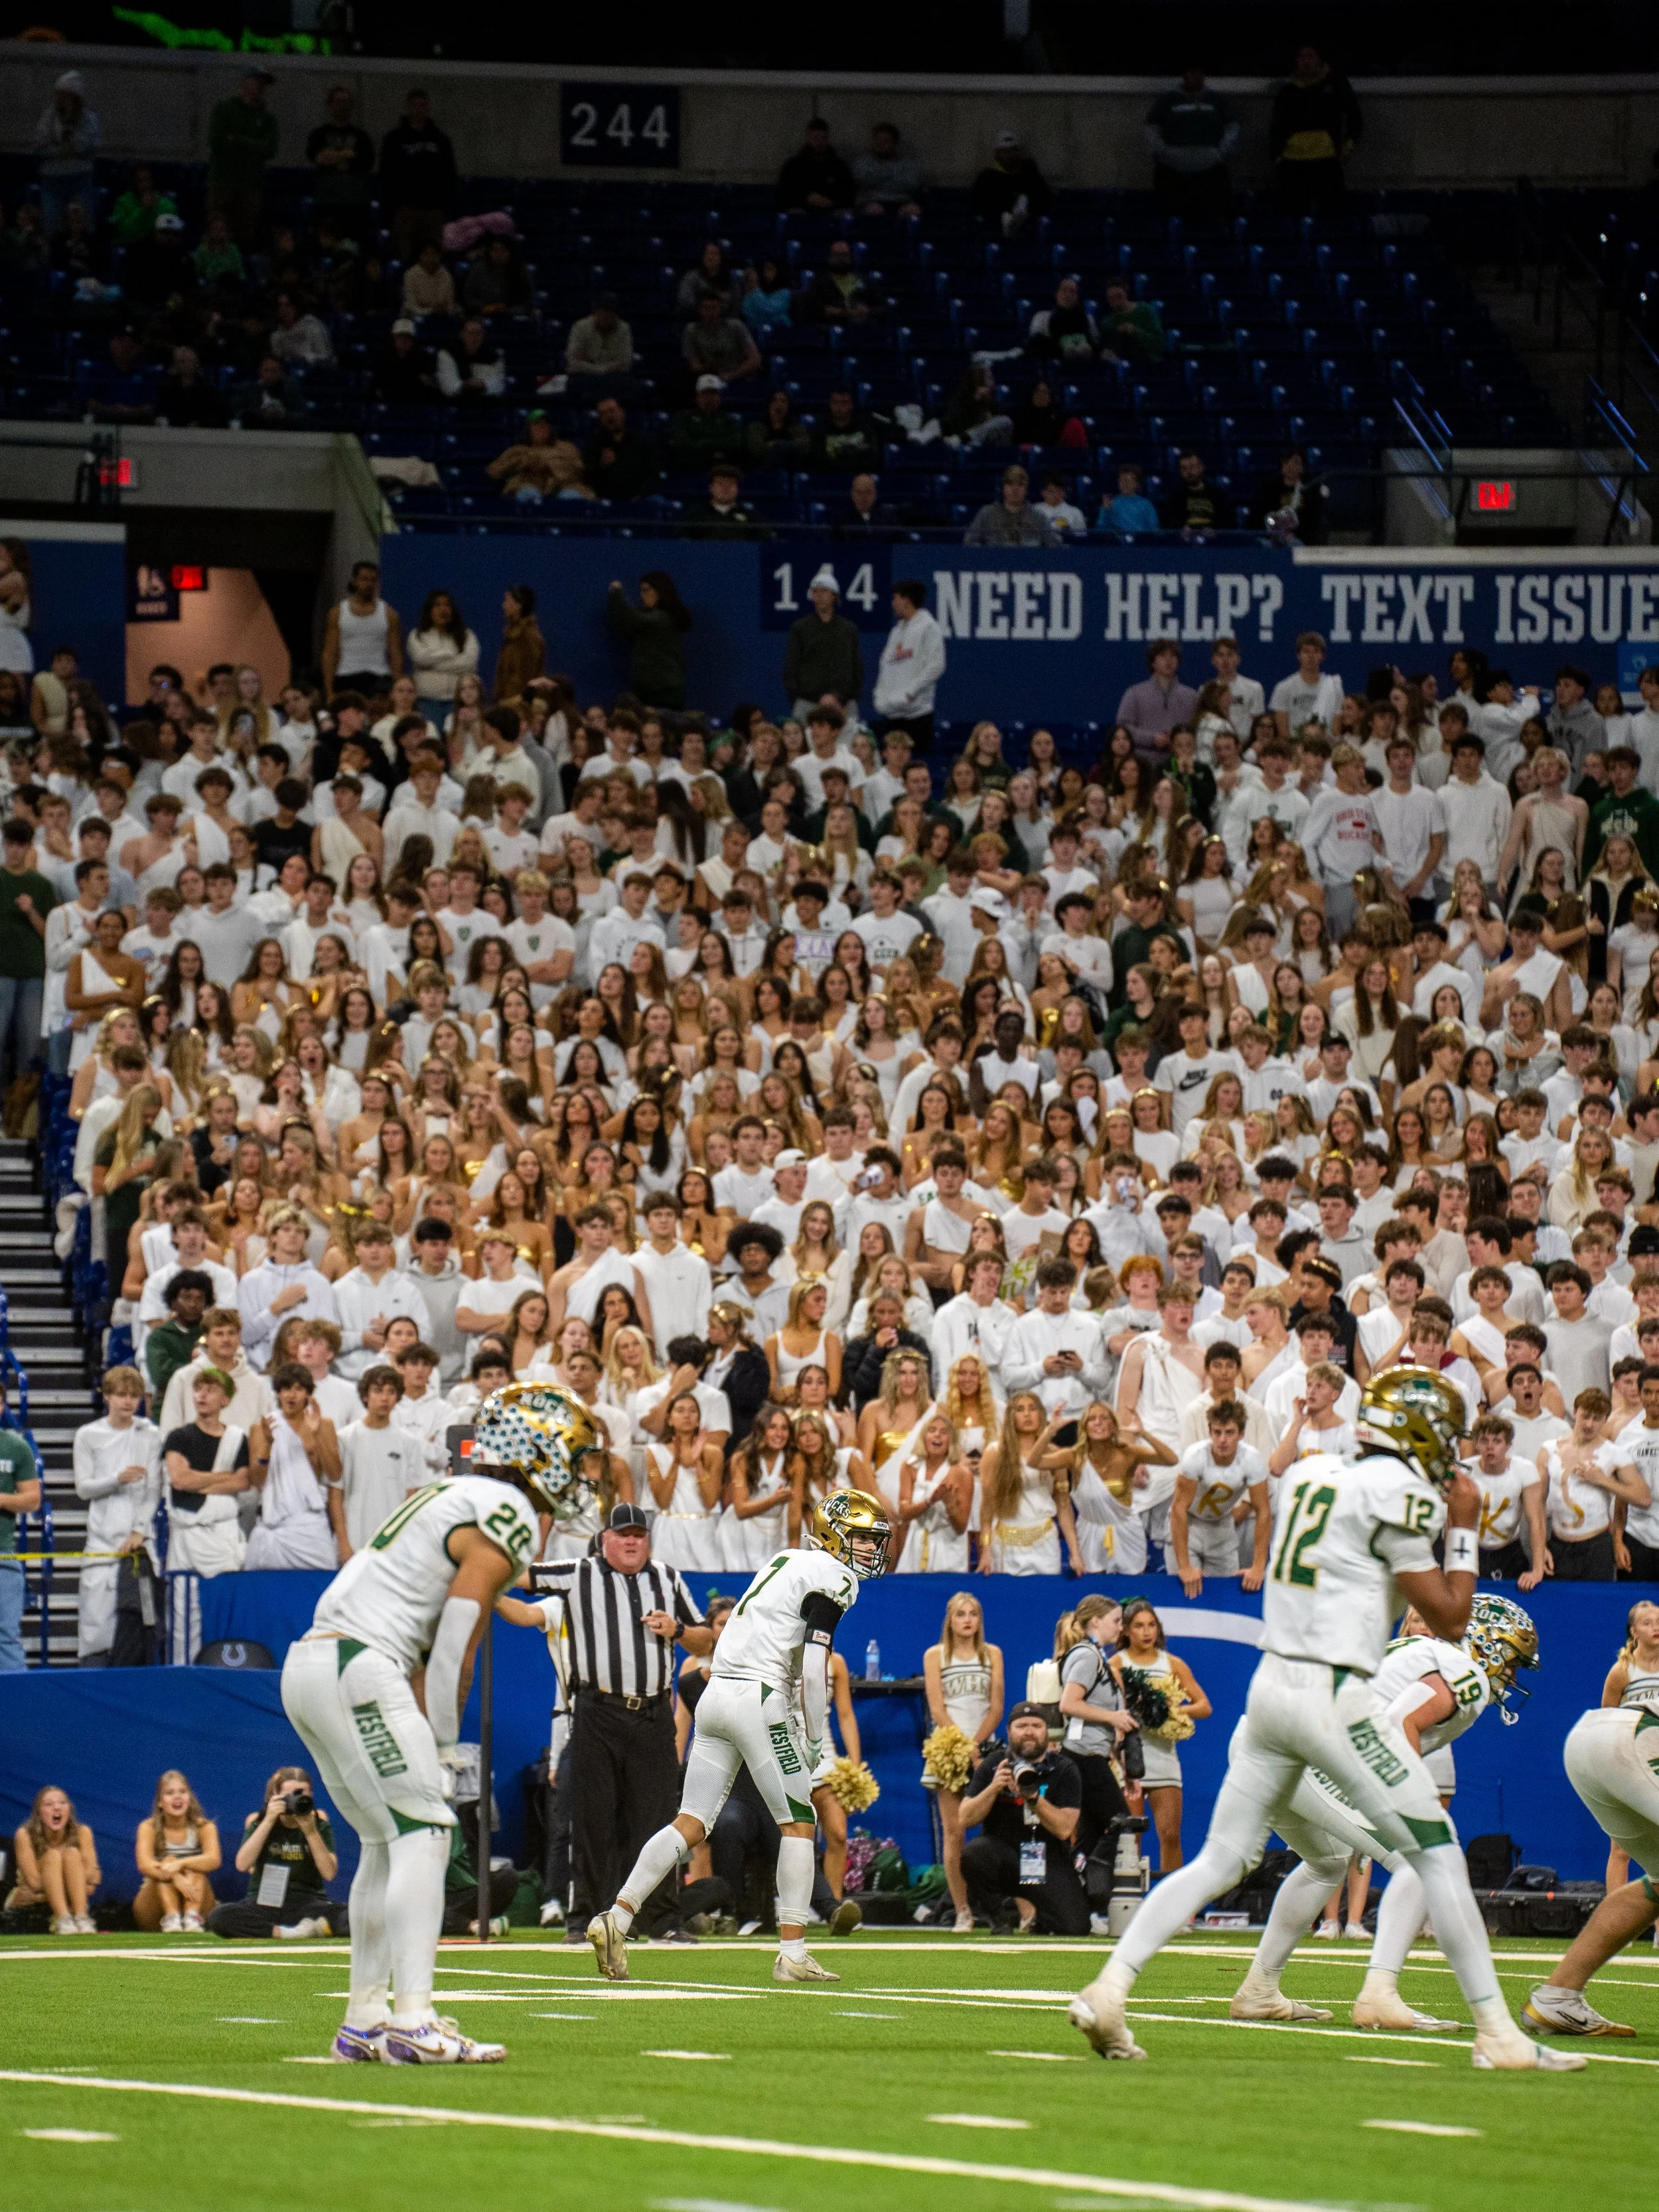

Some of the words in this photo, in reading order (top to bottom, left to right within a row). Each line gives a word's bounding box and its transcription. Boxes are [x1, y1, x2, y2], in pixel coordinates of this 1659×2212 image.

[571, 102, 670, 148] 244
[774, 563, 878, 611] 14
[933, 571, 1082, 640] NEED
[1104, 573, 1284, 642] HELP?
[1321, 574, 1475, 643] TEXT
[1494, 575, 1659, 643] ISSUE
[1636, 1446, 1659, 1458] HAWKE
[484, 1501, 532, 1555] 20
[1273, 1479, 1337, 1589] 12
[1404, 1492, 1435, 1534] 12
[737, 1555, 791, 1617] 7
[837, 1575, 853, 1598] 7
[1452, 1668, 1482, 1706] 19
[350, 1698, 409, 1779] WESTFIELD
[768, 1721, 802, 1775] WESTFIELD
[1346, 1716, 1411, 1788] WESTFIELD
